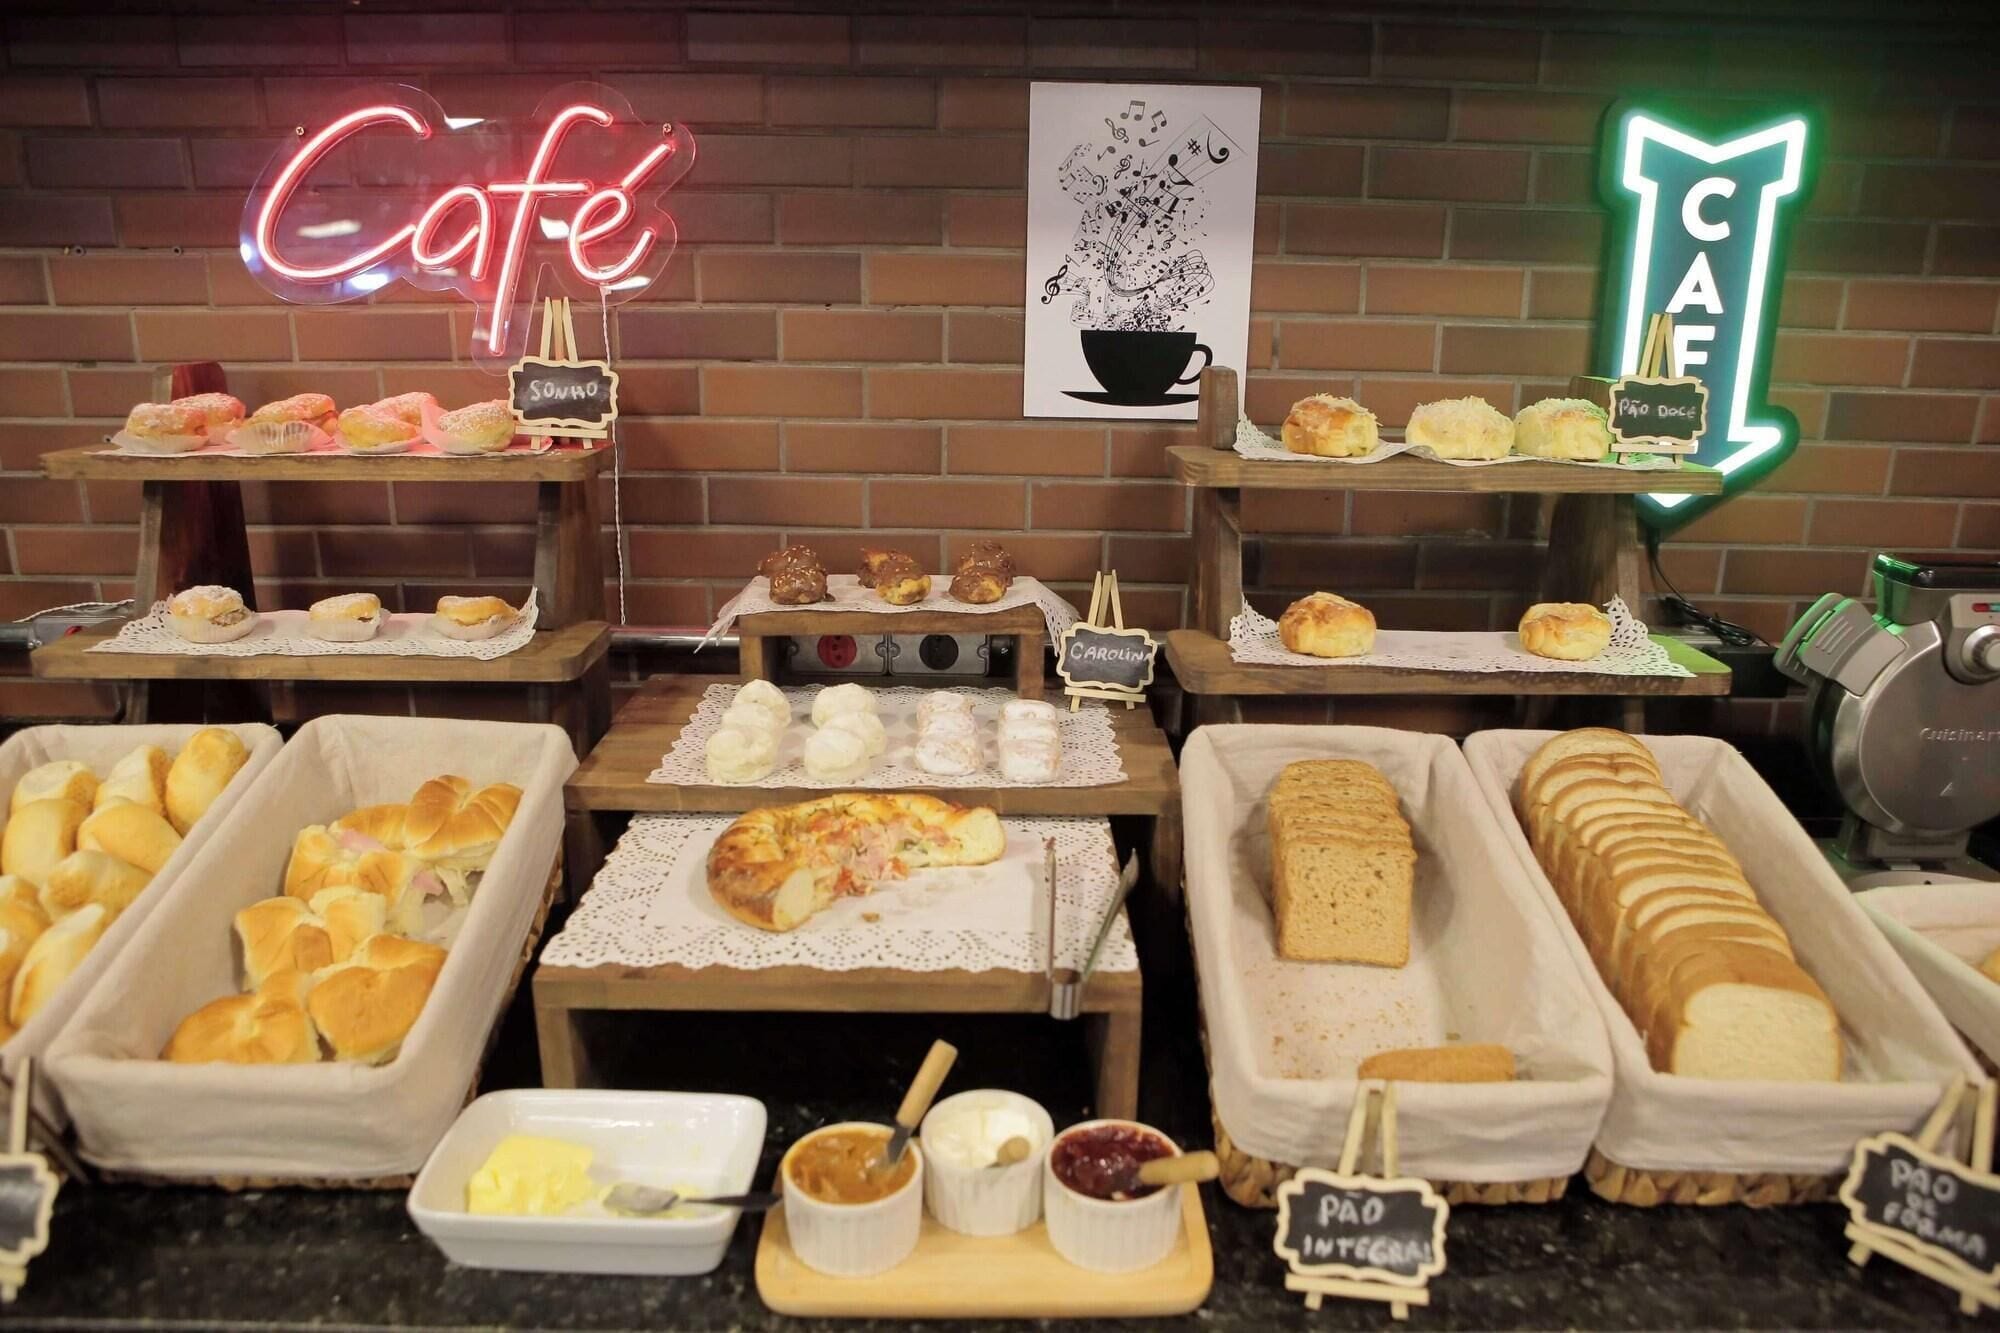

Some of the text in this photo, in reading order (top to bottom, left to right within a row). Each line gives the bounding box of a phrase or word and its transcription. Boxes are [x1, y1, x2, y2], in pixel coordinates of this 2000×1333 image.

[257, 104, 674, 355] Café
[1659, 177, 1737, 454] CAF
[529, 379, 599, 401] SONHO
[1318, 1190, 1386, 1228] PÃO
